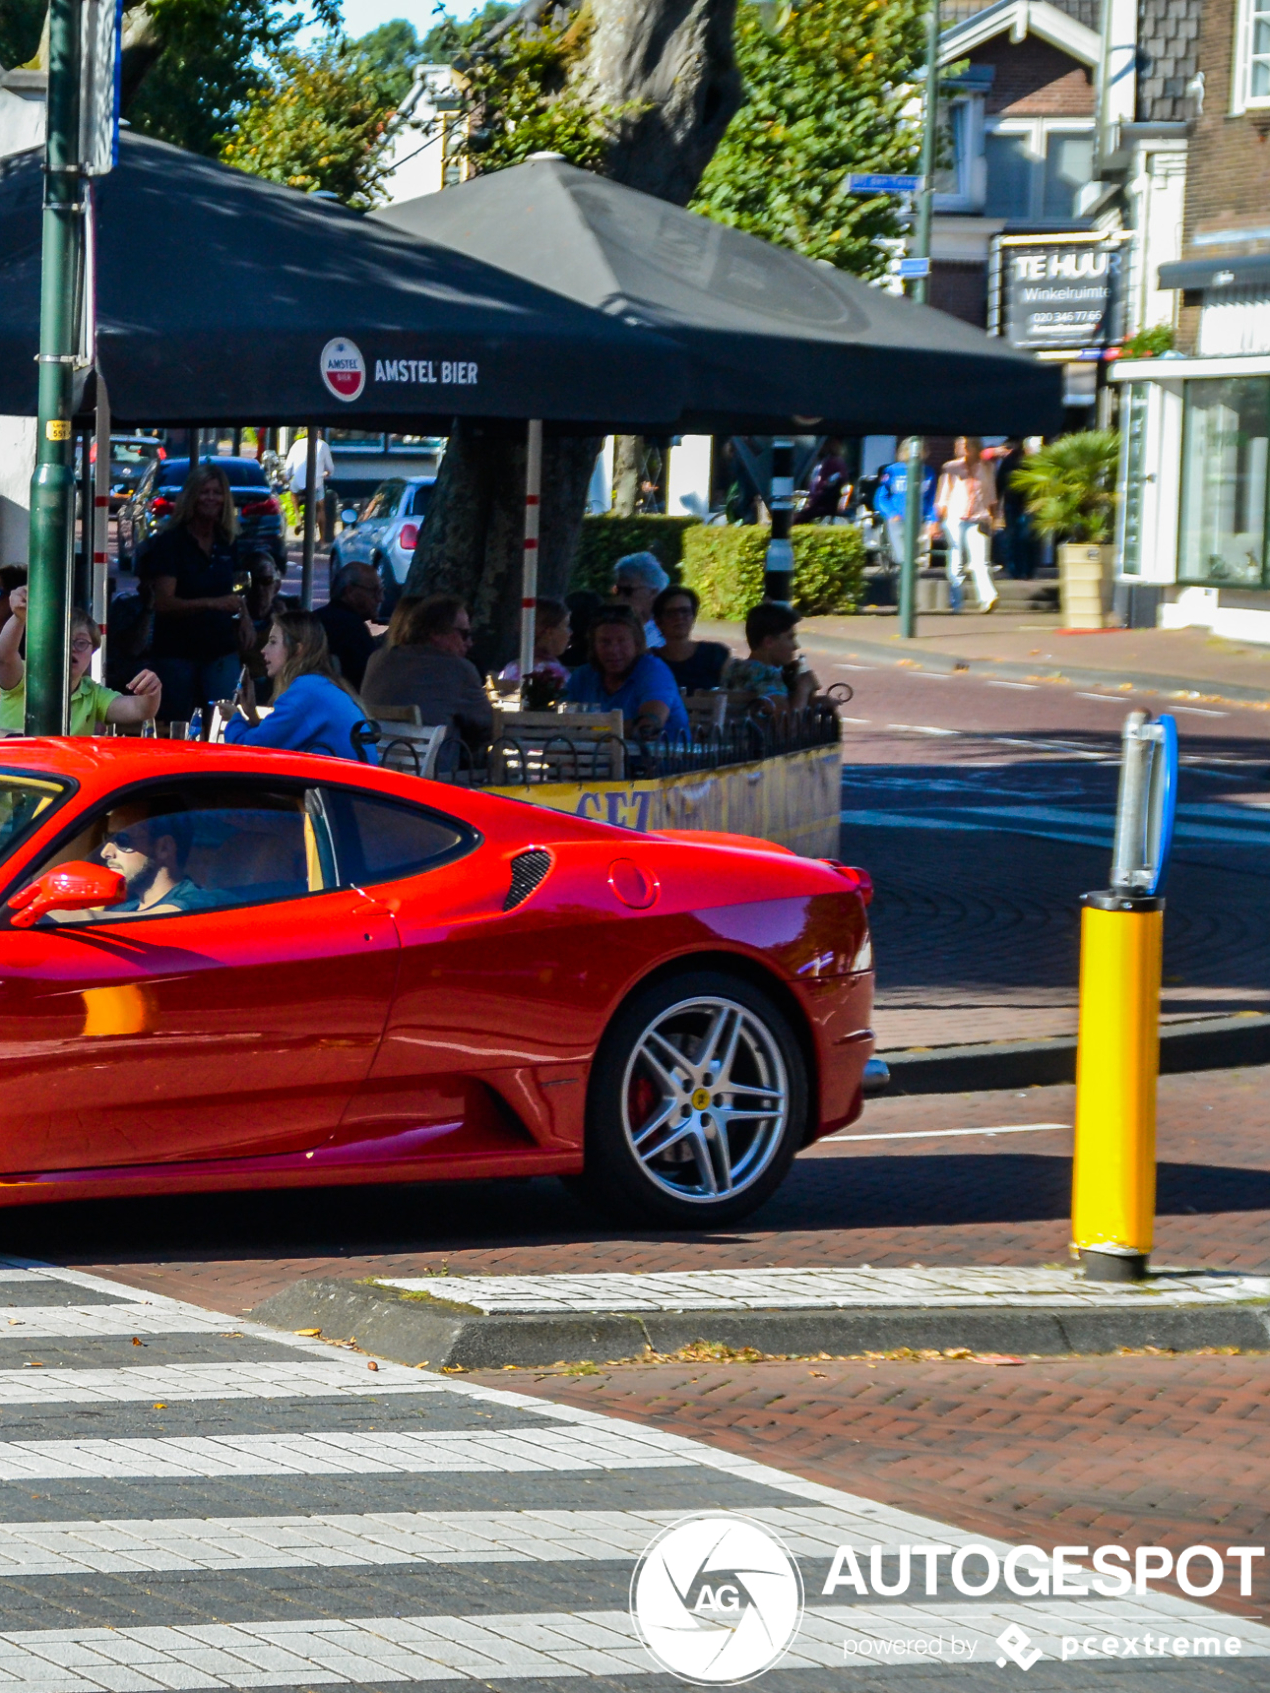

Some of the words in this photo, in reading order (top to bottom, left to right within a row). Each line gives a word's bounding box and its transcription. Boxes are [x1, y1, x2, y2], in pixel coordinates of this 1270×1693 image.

[1016, 255, 1047, 280] TE
[1048, 252, 1122, 280] HUUR
[1024, 285, 1111, 300] Winkelruimte
[1033, 312, 1052, 322] 020
[328, 358, 357, 369] AMSTEL
[375, 360, 437, 383] AMSTEL
[441, 361, 478, 385] BIER
